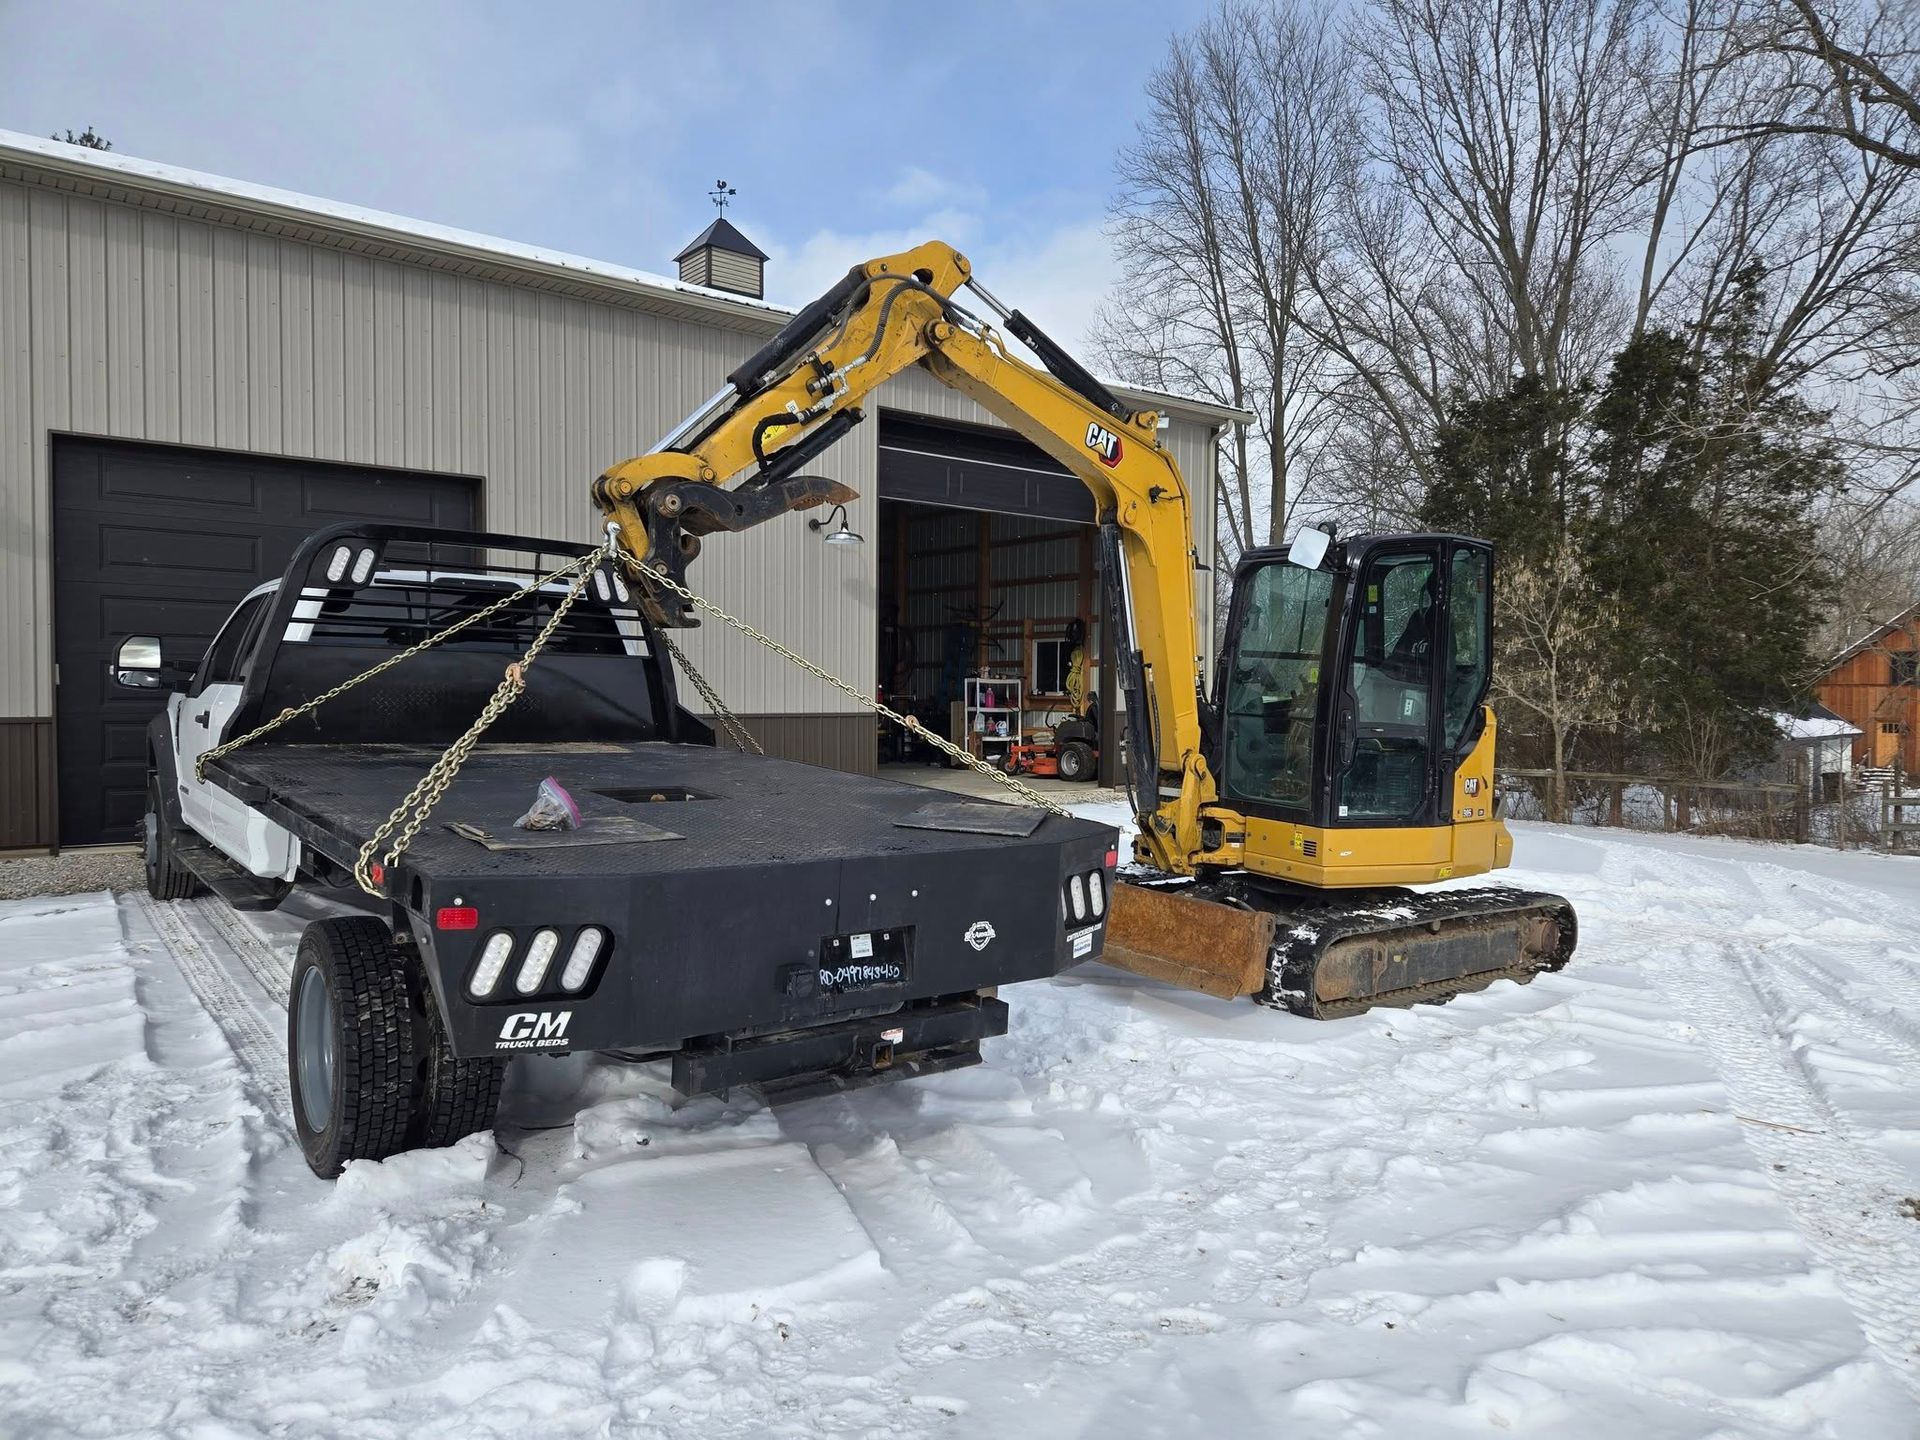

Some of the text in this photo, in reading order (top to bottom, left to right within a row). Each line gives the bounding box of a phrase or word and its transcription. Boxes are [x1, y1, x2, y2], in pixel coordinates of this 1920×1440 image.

[1085, 422, 1118, 459] CAT
[1464, 778, 1478, 794] CAT
[499, 1011, 573, 1040] CM
[495, 1038, 569, 1049] TRUCK BEDS
